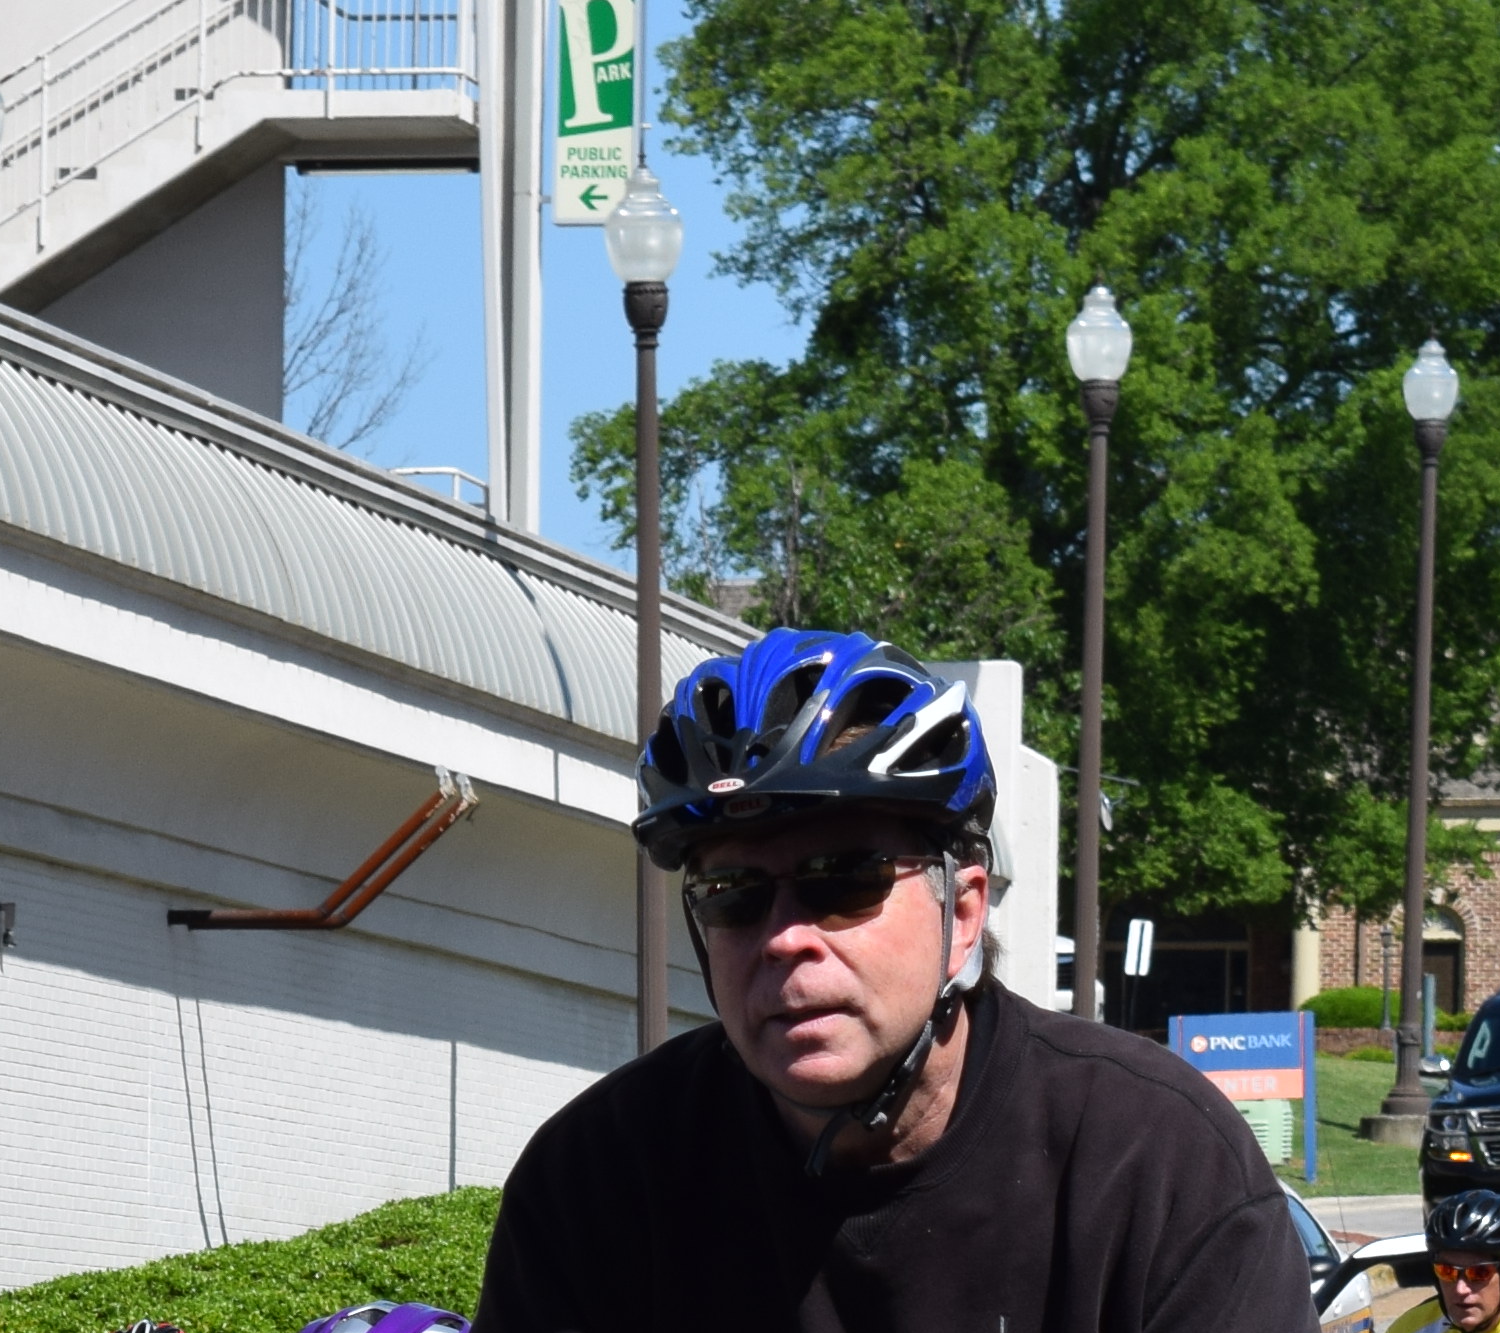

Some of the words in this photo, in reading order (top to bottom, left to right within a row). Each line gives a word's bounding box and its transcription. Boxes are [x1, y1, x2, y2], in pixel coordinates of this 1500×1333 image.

[567, 147, 622, 162] PUBLIC
[560, 165, 628, 180] PARKING
[712, 781, 738, 790] BELL
[1210, 1036, 1246, 1050] PNC
[1248, 1033, 1293, 1048] BANK
[1216, 1076, 1278, 1094] NTER
